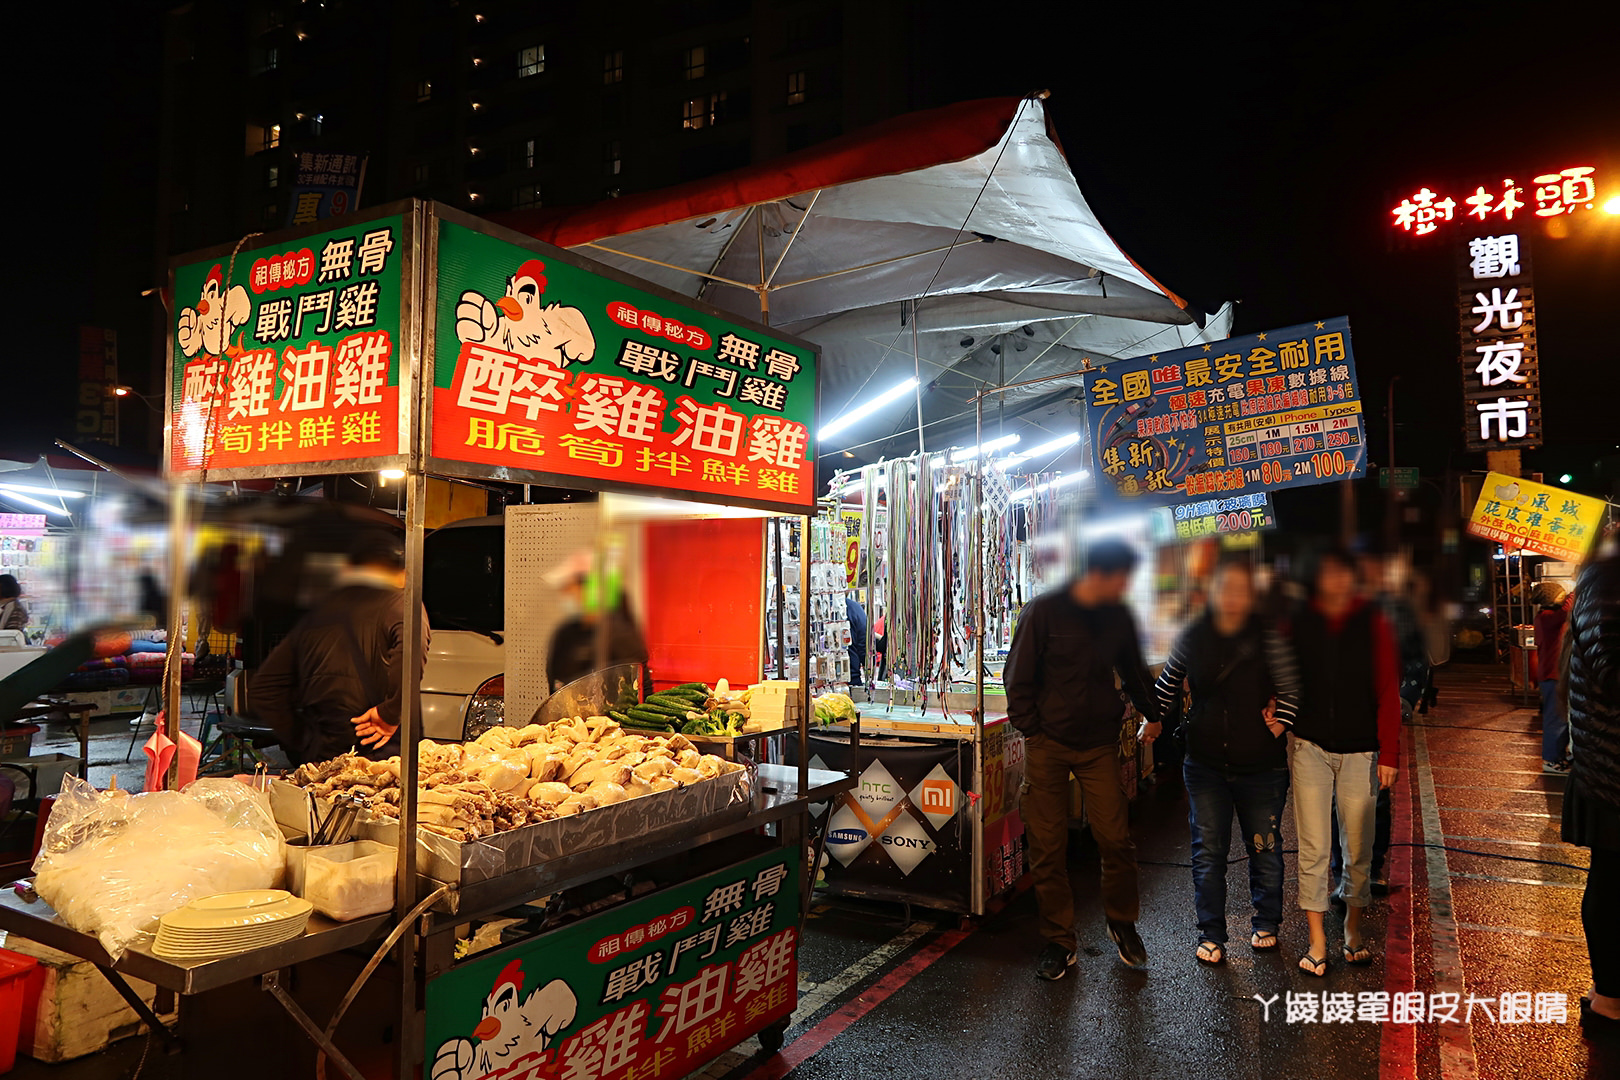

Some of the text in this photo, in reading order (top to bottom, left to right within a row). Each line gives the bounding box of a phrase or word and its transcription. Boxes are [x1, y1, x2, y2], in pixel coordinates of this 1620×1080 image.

[1392, 166, 1596, 236] 樹林頭
[255, 256, 310, 287] 祖傳秘方
[319, 229, 393, 283] 無骨
[254, 284, 379, 342] 戰鬥雞
[616, 306, 705, 346] 祖傳秘方
[1469, 234, 1529, 442] 觀光夜市
[184, 334, 388, 421] 醉雞油雞
[619, 340, 788, 411] 戰鬥雞
[717, 332, 801, 381] 無骨
[1091, 331, 1347, 407] 全國唯一最安全耐用
[184, 411, 381, 457] 筍拌鮮雞
[456, 346, 806, 470] 醉雞油雞
[1229, 418, 1349, 446] 25cm 1M 1.5M 2M
[464, 417, 800, 495] 脆筍拌鮮雞
[1203, 424, 1226, 468] 展示特價
[828, 831, 862, 842] SAMSUNG
[881, 836, 931, 850] SONY
[701, 863, 788, 924] 無骨
[598, 910, 690, 958] 祖傳秘方
[602, 902, 774, 1004] 戰鬥雞
[479, 931, 796, 1080] 雞油雞
